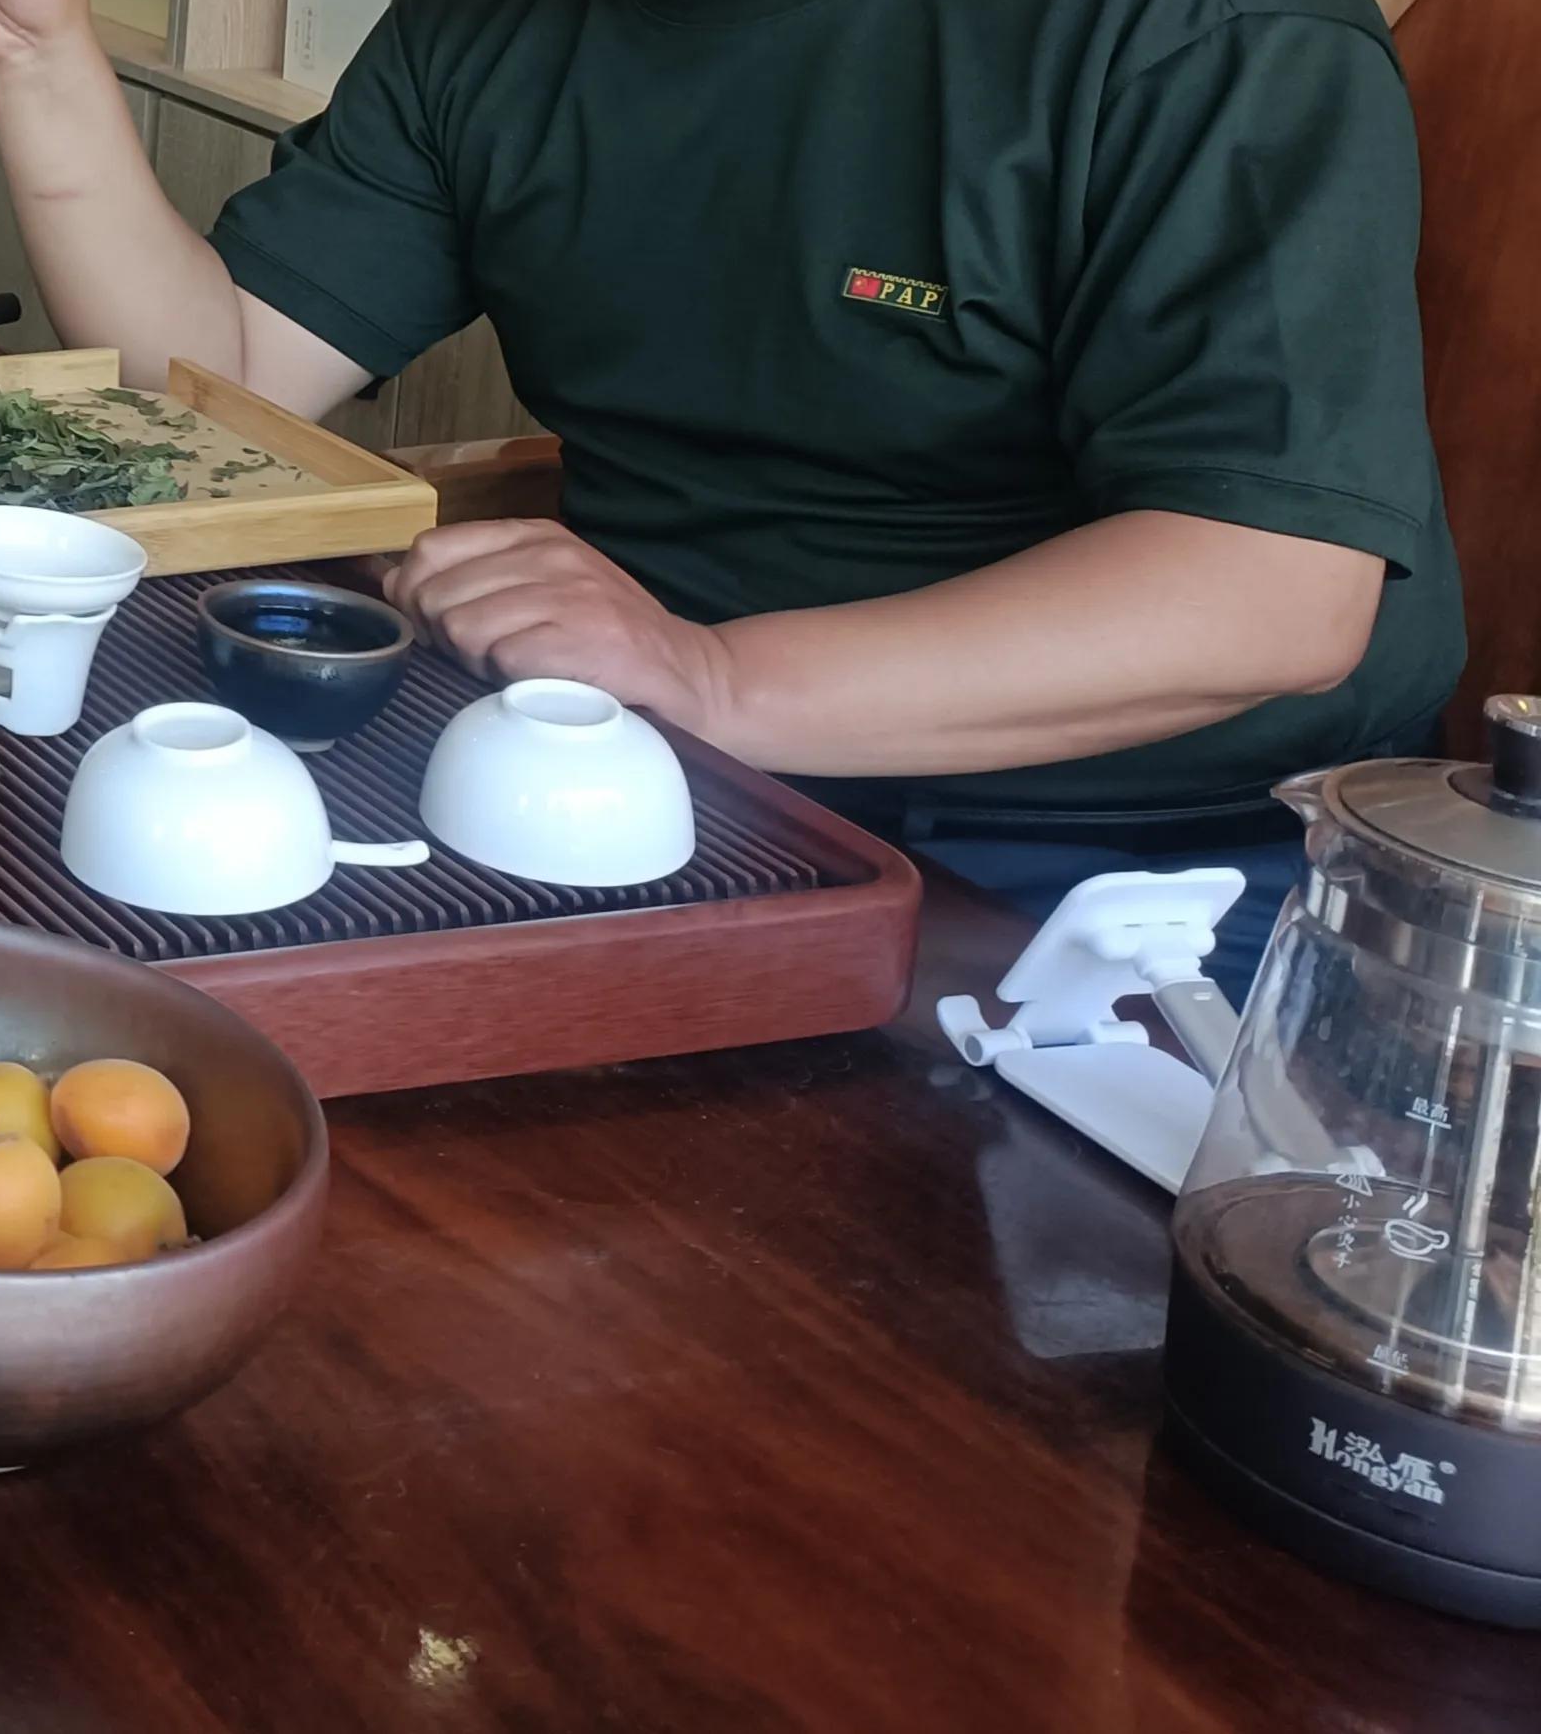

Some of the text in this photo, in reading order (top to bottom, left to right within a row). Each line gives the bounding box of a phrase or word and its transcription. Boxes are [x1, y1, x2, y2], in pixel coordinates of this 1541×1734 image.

[879, 280, 939, 309] PAP
[1411, 1096, 1450, 1123] 最高
[1308, 1416, 1446, 1506] Hongyan
